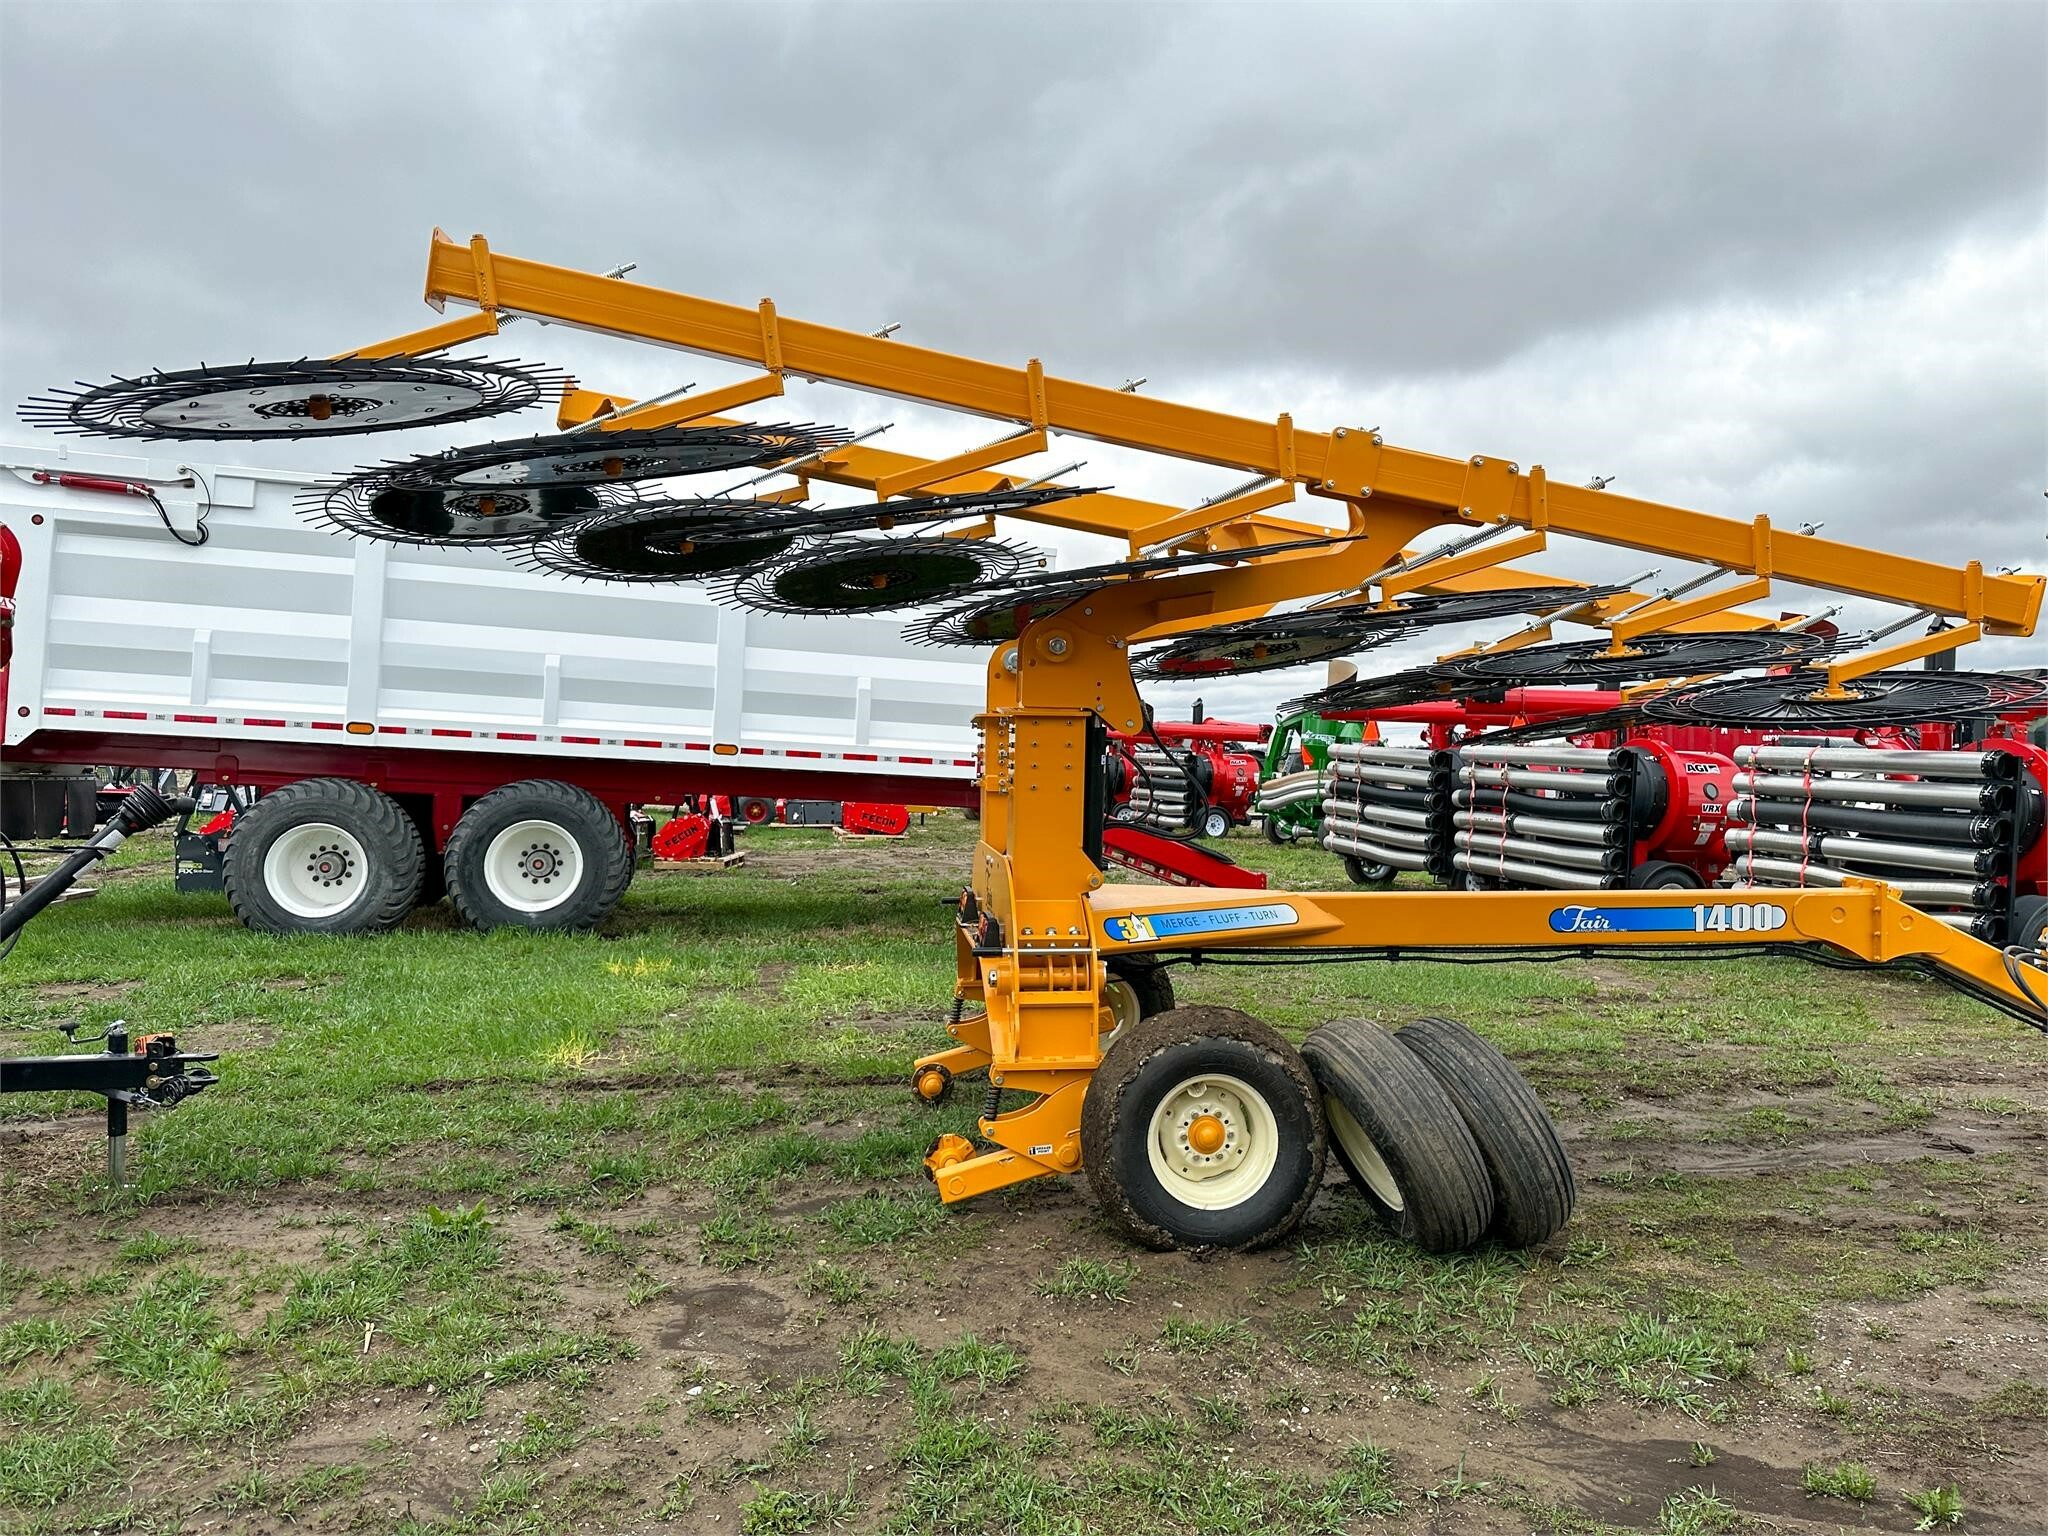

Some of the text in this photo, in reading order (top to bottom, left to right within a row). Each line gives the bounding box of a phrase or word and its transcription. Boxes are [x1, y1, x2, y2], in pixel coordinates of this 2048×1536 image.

[1687, 764, 1708, 773] AGI
[1702, 804, 1721, 813] VRX
[862, 812, 896, 827] FECON
[665, 826, 698, 847] FECON
[1160, 915, 1200, 929] MERGE
[1209, 912, 1241, 925] FLUFF
[1249, 909, 1279, 921] TURN
[1560, 903, 1773, 932] Fair 1400
[1116, 918, 1139, 940] 3
[1141, 916, 1156, 938] 1
